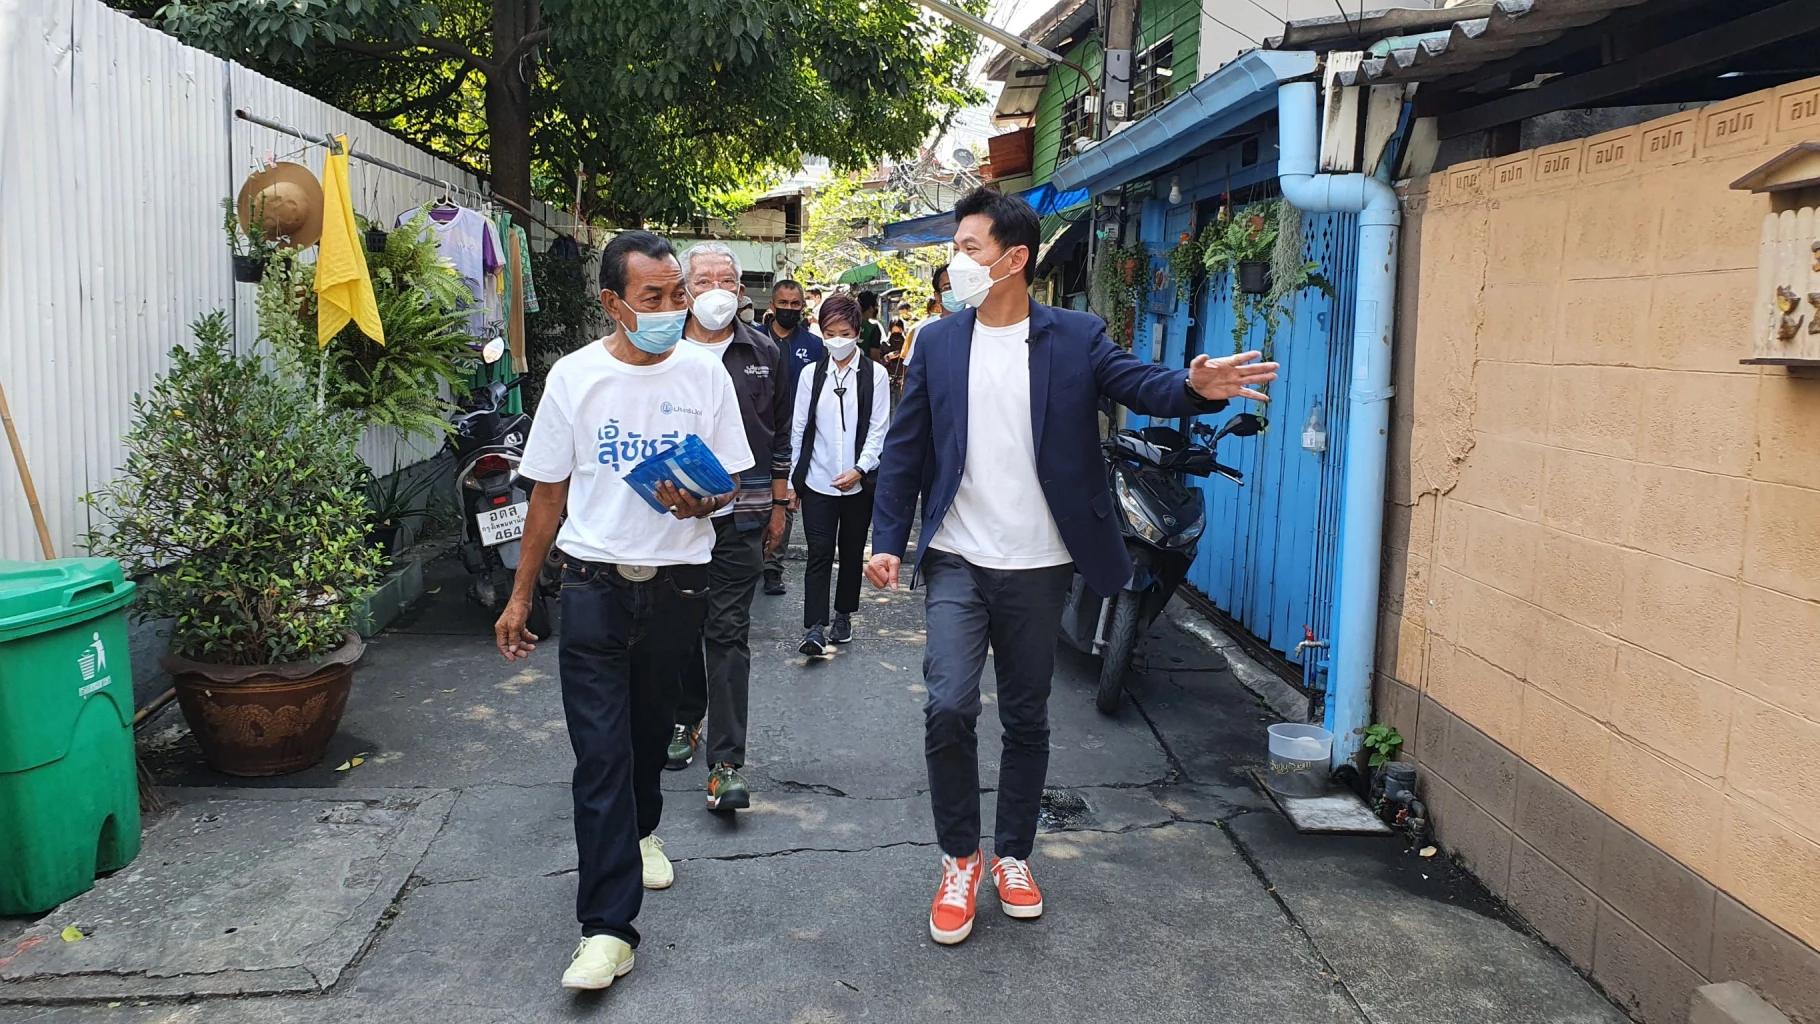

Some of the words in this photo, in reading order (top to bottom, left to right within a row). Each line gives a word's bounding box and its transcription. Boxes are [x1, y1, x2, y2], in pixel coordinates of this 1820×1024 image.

[1716, 112, 1754, 137] อปก
[1650, 129, 1683, 152] อปก
[1595, 143, 1624, 164] อปก
[795, 347, 808, 359] 42
[598, 418, 620, 441] เอ้
[598, 430, 691, 472] สุชัชวี
[482, 516, 526, 533] กรุงเทพมหานค
[495, 526, 522, 541] 464
